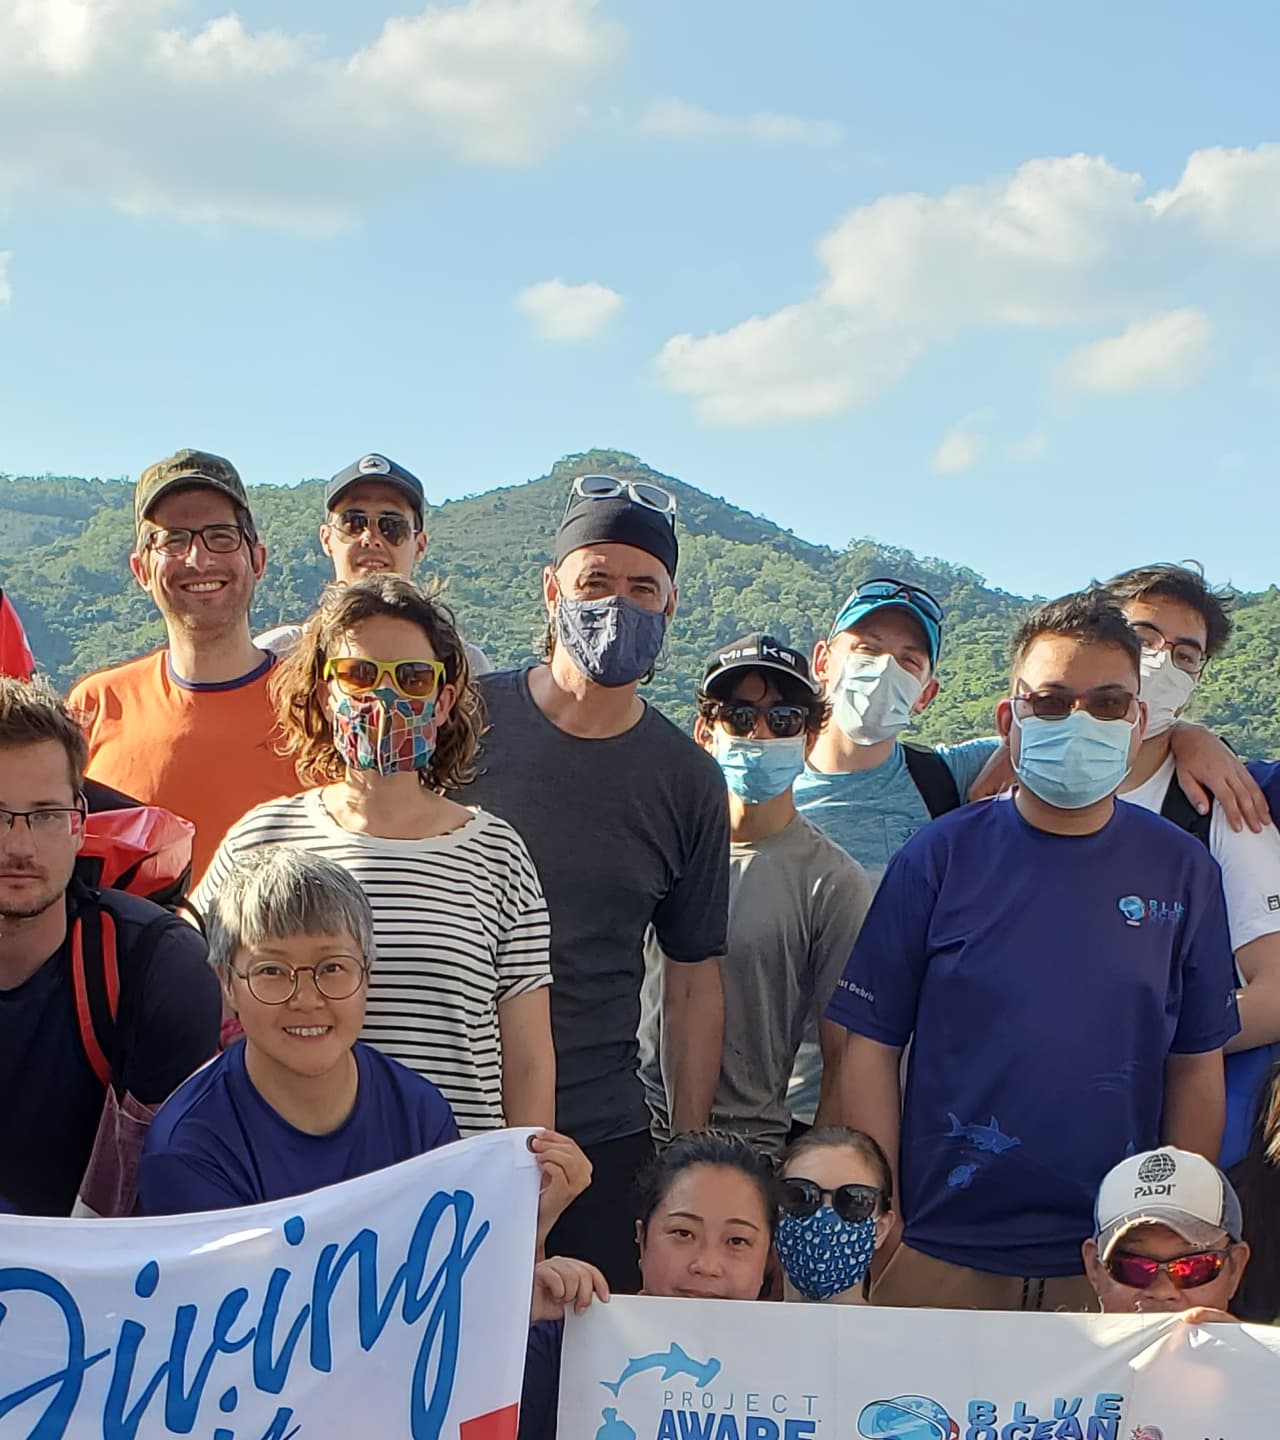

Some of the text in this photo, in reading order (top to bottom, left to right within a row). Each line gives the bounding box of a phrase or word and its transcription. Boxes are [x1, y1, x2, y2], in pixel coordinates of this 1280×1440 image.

[1133, 1183, 1172, 1199] PADI
[662, 1390, 820, 1417] PROJECT
[967, 1393, 1124, 1426] BLUE
